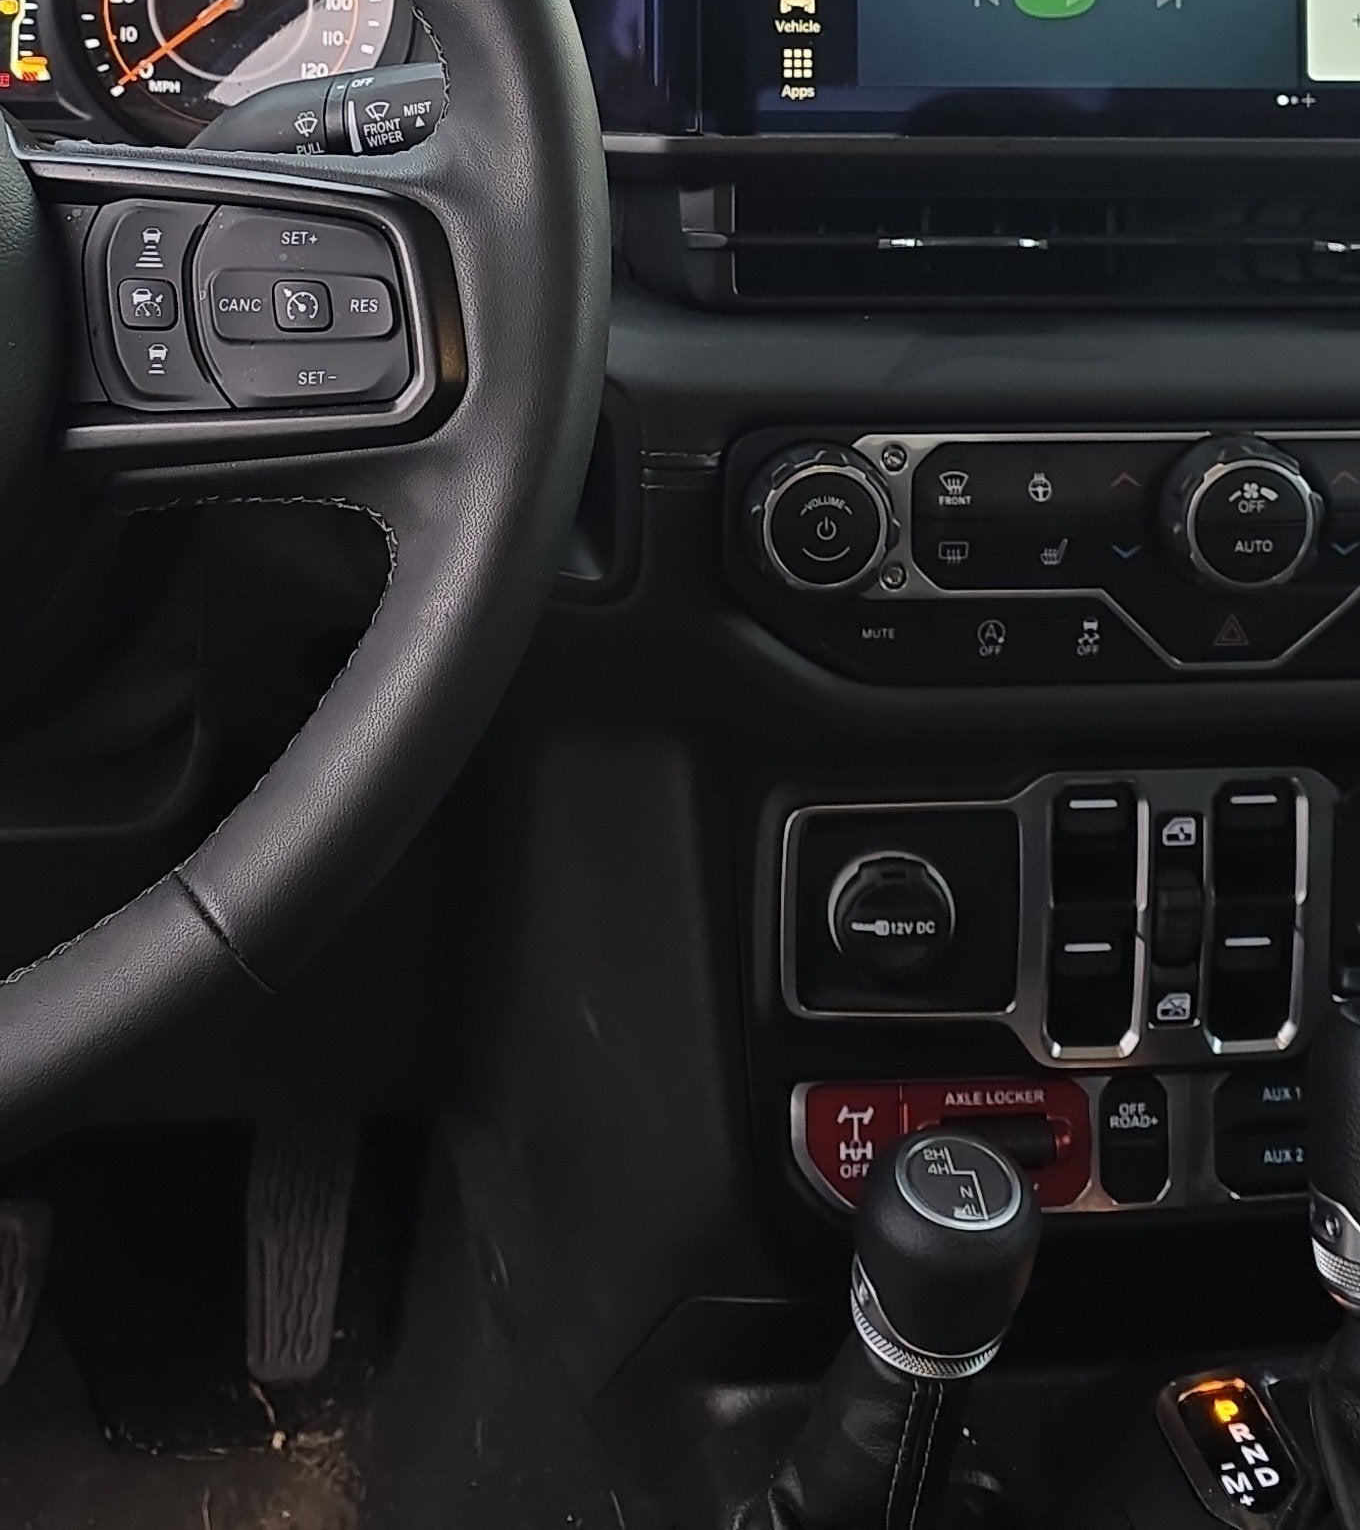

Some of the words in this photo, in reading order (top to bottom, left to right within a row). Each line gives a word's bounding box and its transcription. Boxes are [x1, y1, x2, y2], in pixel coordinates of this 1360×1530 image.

[119, 25, 138, 43] 10
[774, 19, 821, 35] Vehicle
[322, 30, 344, 46] 110
[300, 62, 329, 79] 120
[148, 79, 181, 94] MPH
[351, 76, 375, 89] OFF
[780, 83, 816, 100] Apps
[403, 100, 432, 117] MIST
[363, 117, 402, 136] FRONT
[365, 131, 404, 148] WIPER
[296, 142, 325, 155] PULL
[280, 231, 319, 246] SET+
[218, 298, 262, 313] CANC
[349, 298, 379, 313] RES
[806, 495, 846, 511] VOLUME
[938, 495, 972, 506] FRONT
[1238, 499, 1267, 513] OFF
[1234, 539, 1274, 553] AUTO
[861, 627, 896, 640] MUTE
[978, 644, 1003, 657] OFF
[1076, 644, 1101, 656] OFF
[890, 921, 914, 935] 12V
[916, 921, 936, 935] DC
[944, 1091, 983, 1107] AXLE
[985, 1090, 1046, 1106] LOCKER
[1261, 1086, 1293, 1102] AUX
[1119, 1102, 1147, 1117] OFF
[923, 1147, 946, 1162] 2H
[1262, 1147, 1293, 1164] AUX
[1294, 1146, 1305, 1163] 2
[840, 1163, 870, 1180] OFF
[927, 1163, 951, 1176] 4H
[958, 1184, 975, 1199] N
[1214, 1399, 1239, 1423] P
[1228, 1422, 1256, 1443] R
[1240, 1442, 1271, 1466] N
[1220, 1471, 1254, 1496] M
[1253, 1466, 1280, 1488] D
